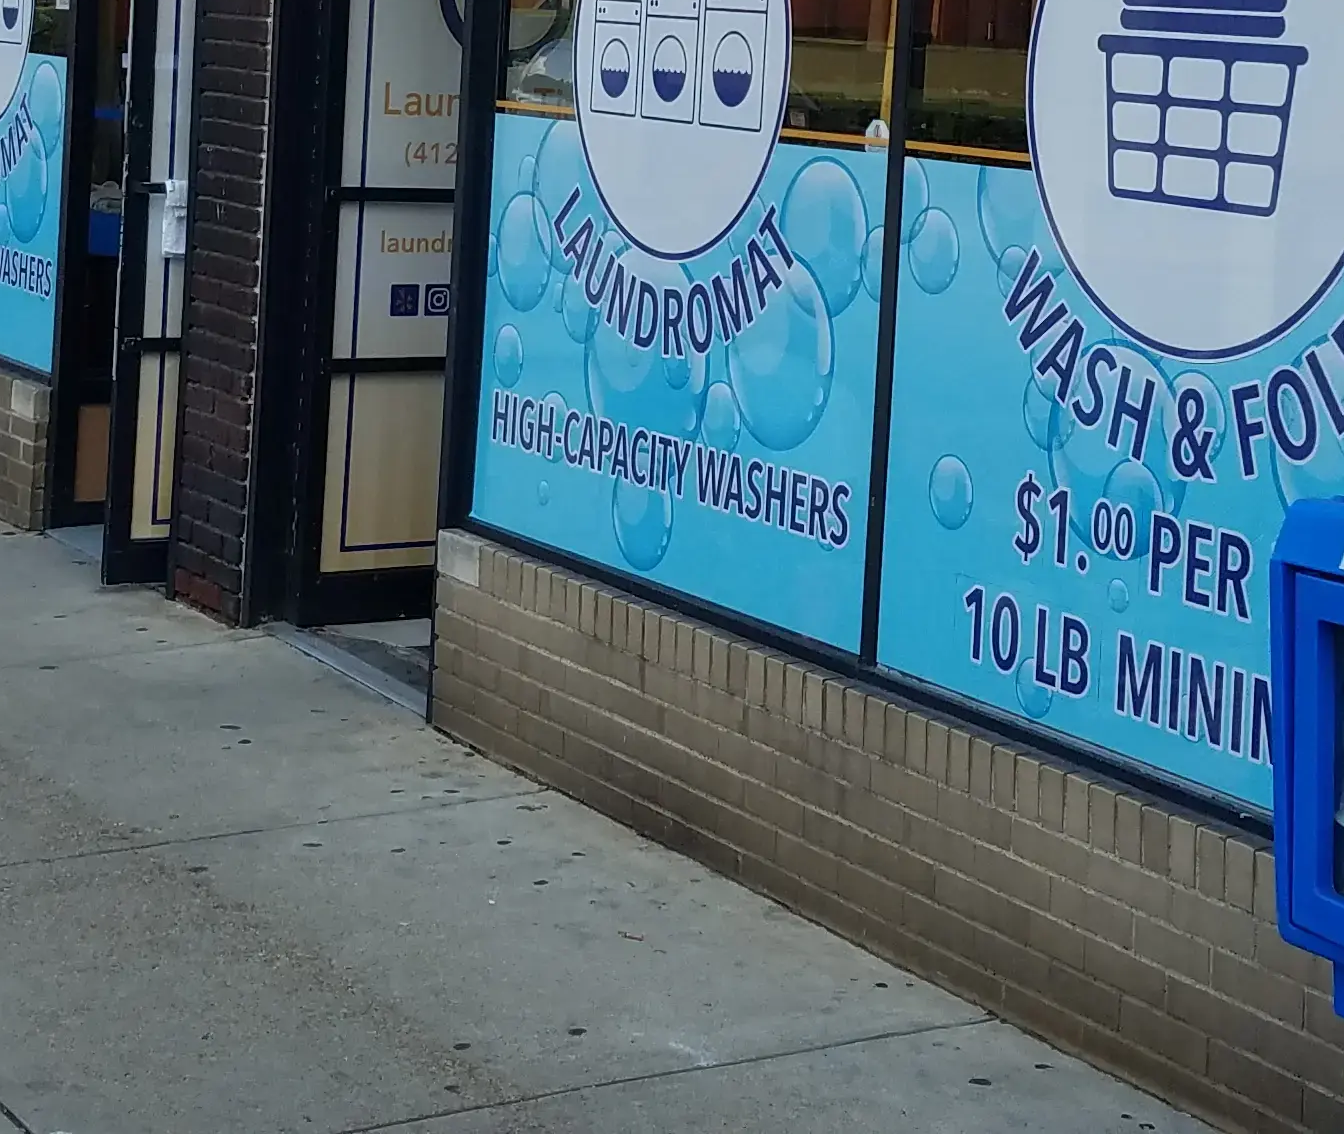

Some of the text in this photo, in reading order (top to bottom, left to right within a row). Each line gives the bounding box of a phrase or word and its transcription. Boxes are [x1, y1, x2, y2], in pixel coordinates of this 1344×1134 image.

[405, 141, 458, 167] (412
[381, 230, 453, 254] laundr
[554, 205, 795, 356] LAUNDROMAT
[1004, 249, 1156, 463] WASH
[1171, 388, 1217, 483] &
[491, 391, 851, 547] HIGH-CAPACITY WASHERS
[1014, 473, 1252, 619] $1.00 PER
[964, 588, 1018, 672] 10
[1035, 607, 1089, 694] LB
